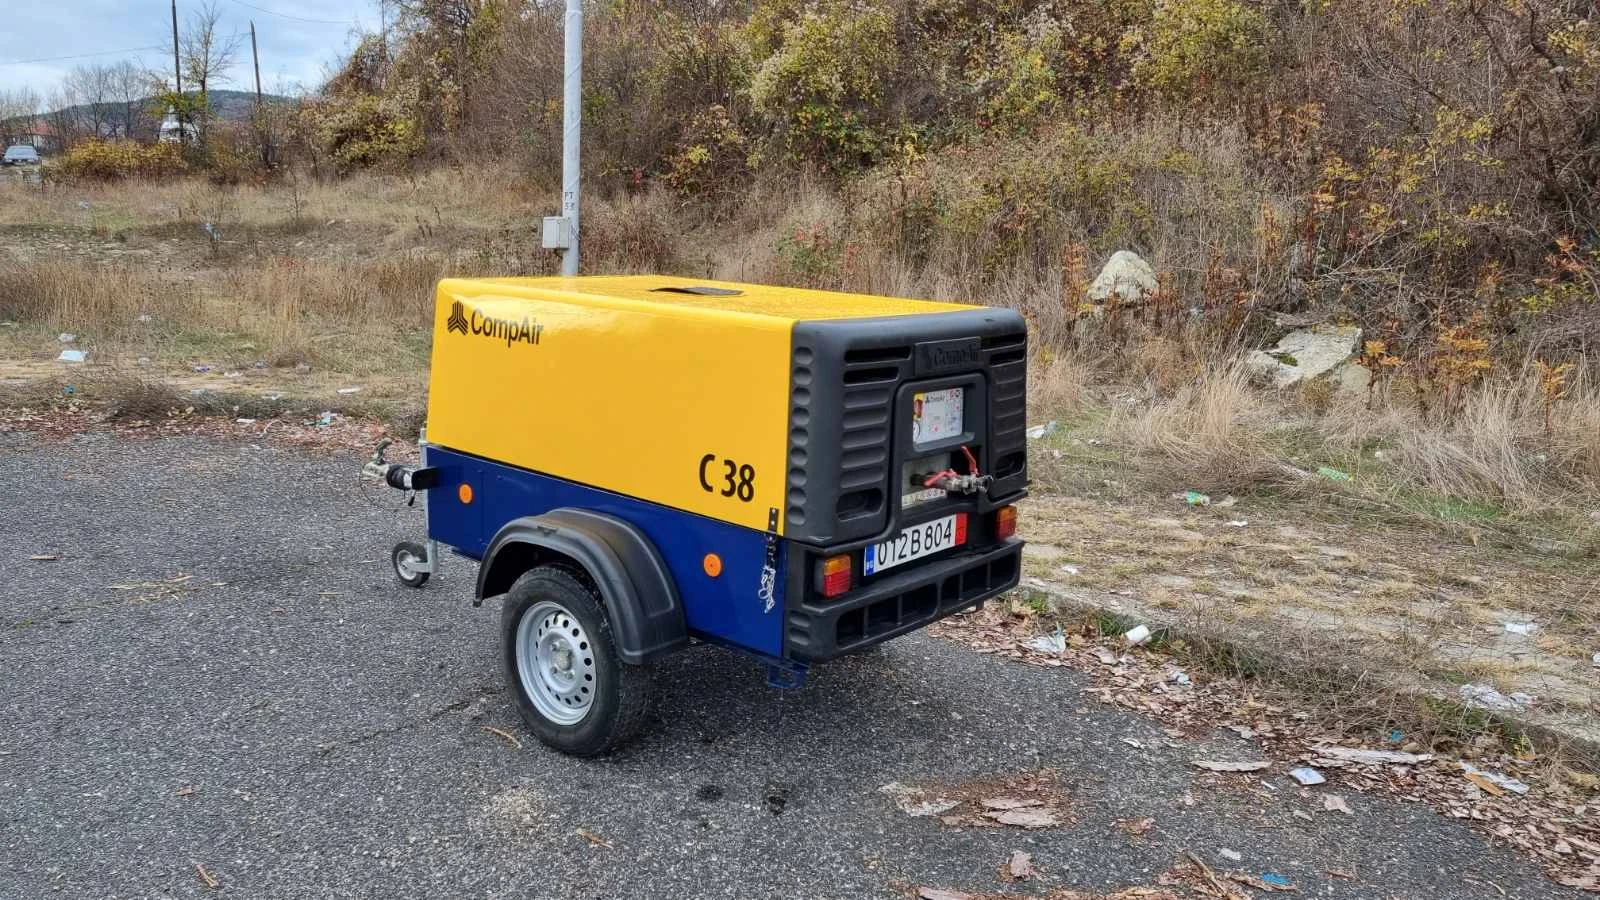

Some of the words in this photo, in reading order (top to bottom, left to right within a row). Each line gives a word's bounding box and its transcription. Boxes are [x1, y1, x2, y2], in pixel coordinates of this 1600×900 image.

[471, 307, 544, 348] CompAir
[699, 453, 716, 493] C
[721, 459, 755, 503] 38
